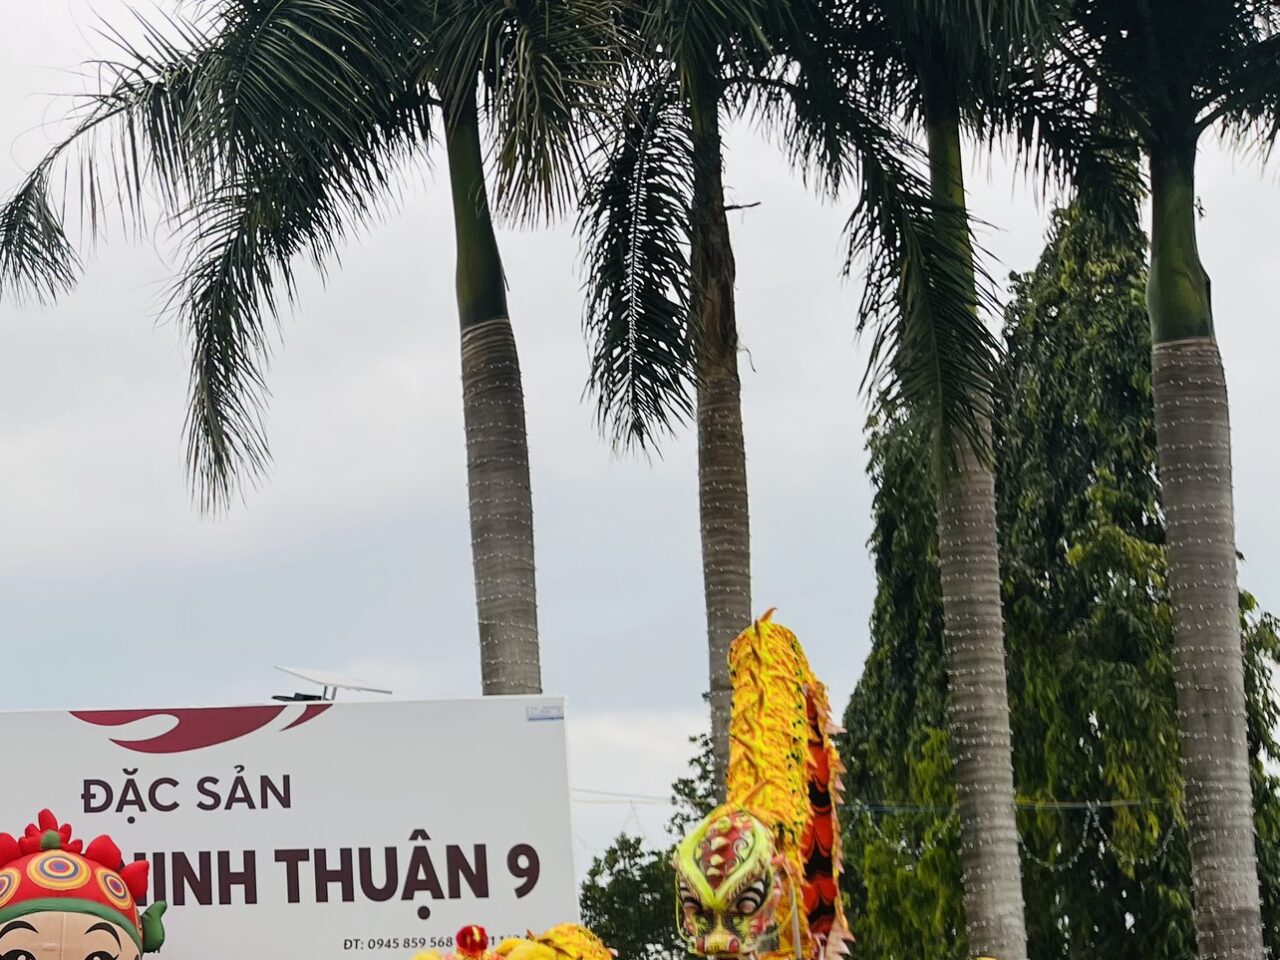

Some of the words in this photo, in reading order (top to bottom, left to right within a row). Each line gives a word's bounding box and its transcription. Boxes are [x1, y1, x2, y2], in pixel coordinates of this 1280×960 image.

[81, 768, 179, 824] ĐẶC
[196, 765, 292, 811] SẢN
[274, 829, 490, 921] THUẬN
[506, 843, 540, 899] 9
[343, 938, 364, 950] ĐT:
[368, 937, 400, 950] 0945
[402, 937, 426, 949] 859
[429, 936, 454, 948] 568
